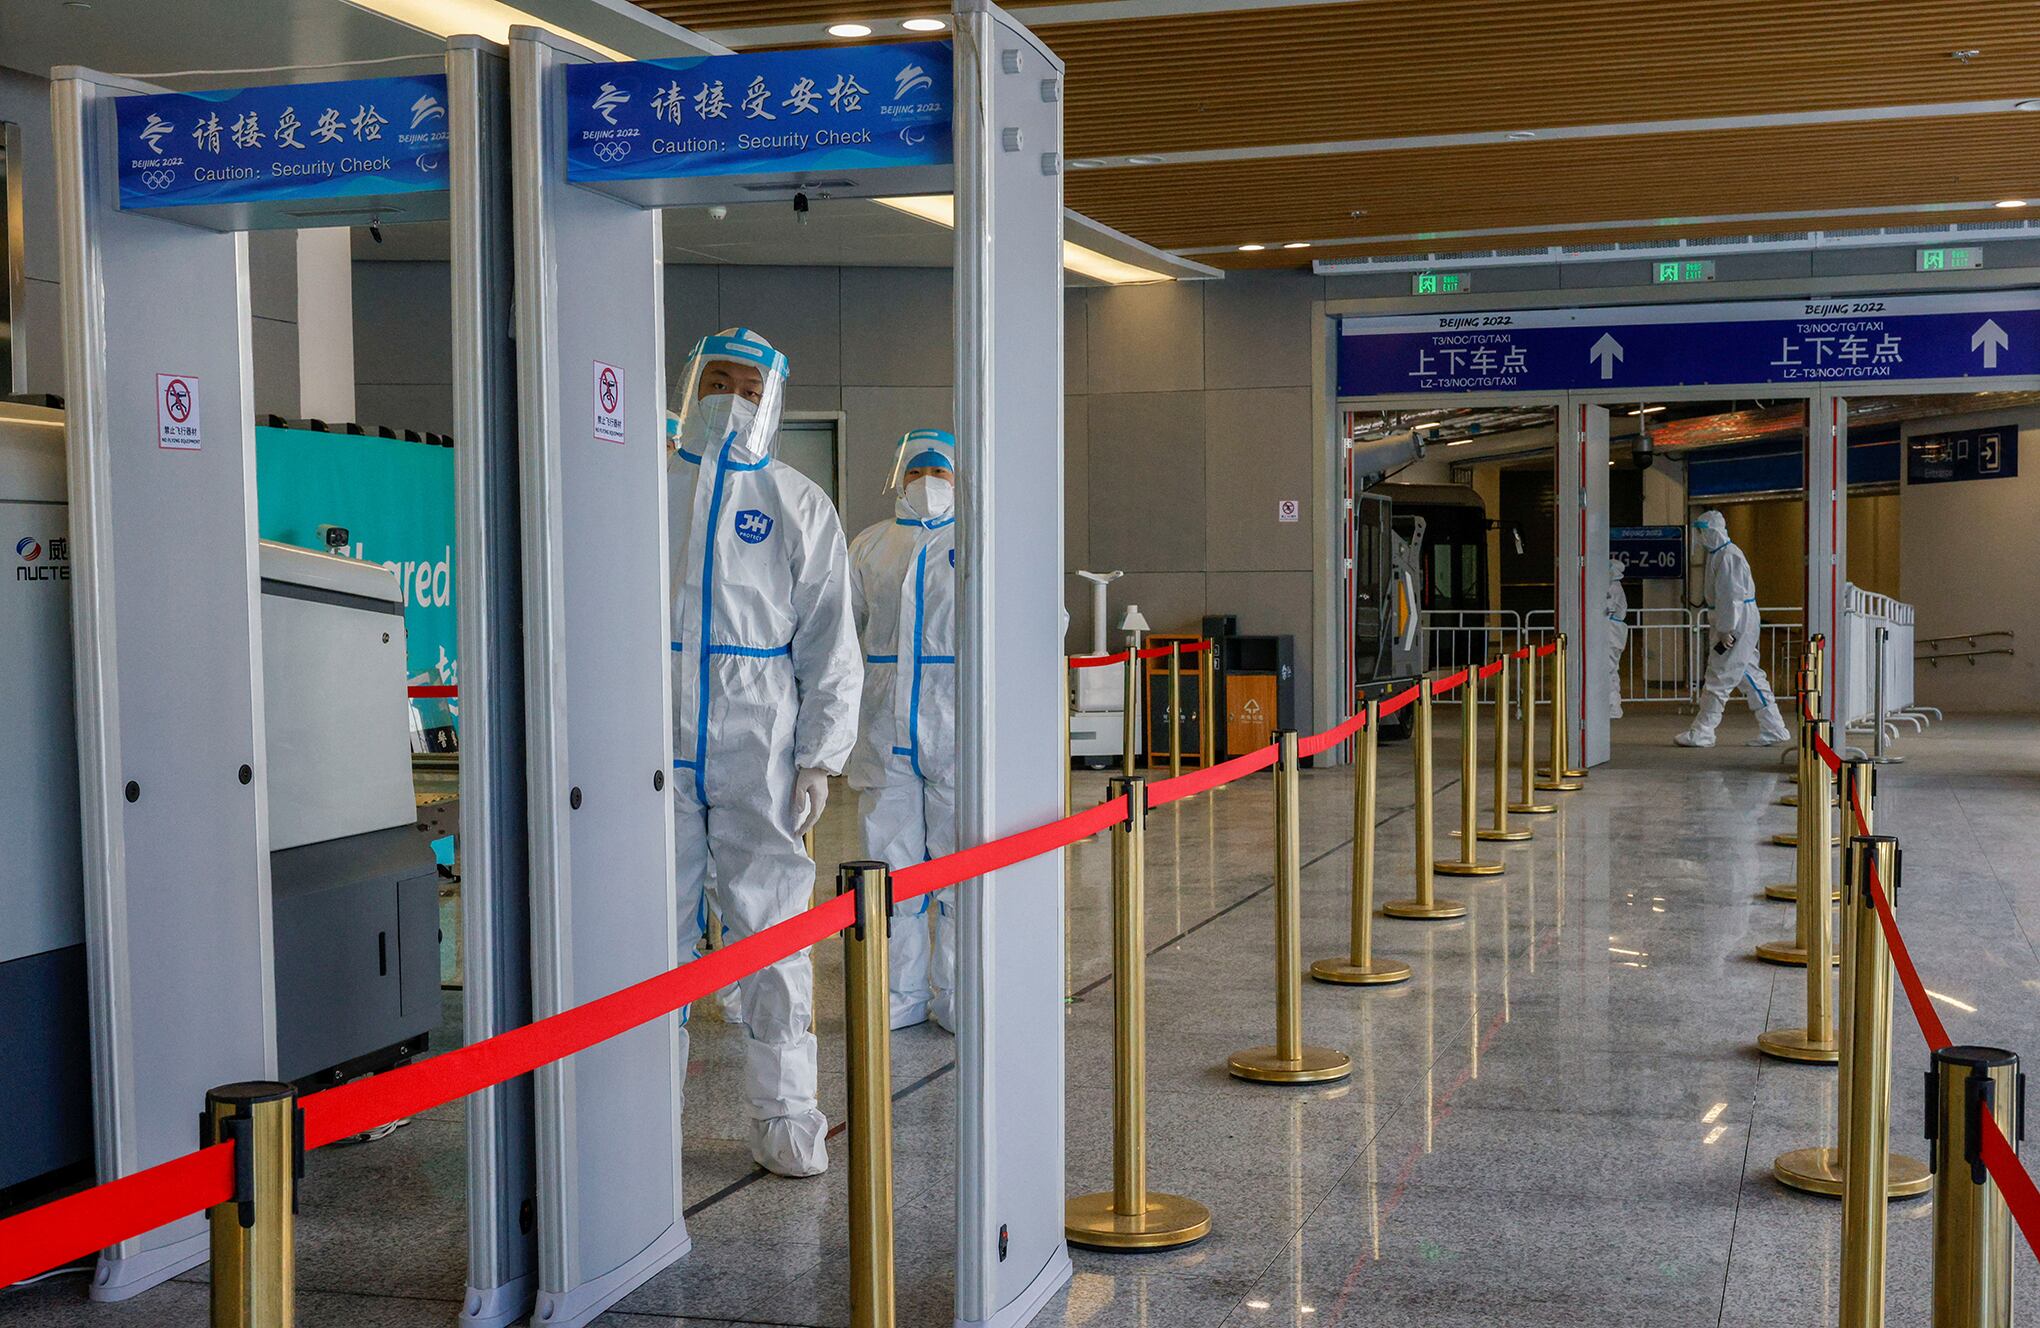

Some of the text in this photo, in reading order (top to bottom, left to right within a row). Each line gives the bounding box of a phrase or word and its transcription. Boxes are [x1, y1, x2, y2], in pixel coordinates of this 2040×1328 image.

[651, 74, 870, 126] 请接受安检
[881, 103, 942, 117] BEIJING 2022
[192, 104, 389, 155] 请接受安检
[583, 128, 640, 142] BEIJING 2022
[399, 134, 428, 145] BEIJING
[652, 128, 872, 154] Caution: Security Check
[131, 157, 184, 170] BEIJING 2022
[194, 156, 391, 182] Caution: Security Check
[1685, 270, 1702, 280] EXIT
[1442, 283, 1458, 292] EXIT
[1805, 302, 1886, 317] BEIJING 2022
[1440, 316, 1514, 330] BEIJING 2022
[1797, 321, 1884, 334] T3/NOC/TG/TAXI
[1432, 334, 1511, 346] T3/NOC/TG/TAXI
[1770, 333, 1903, 366] 上下车点
[1408, 345, 1529, 376] 上下车点
[1783, 366, 1890, 379] LZ-T3/NOC/TG/TAXI
[1420, 377, 1517, 389] LZ-T3/NOC/TG/TAXI
[740, 531, 762, 542] PROTECT
